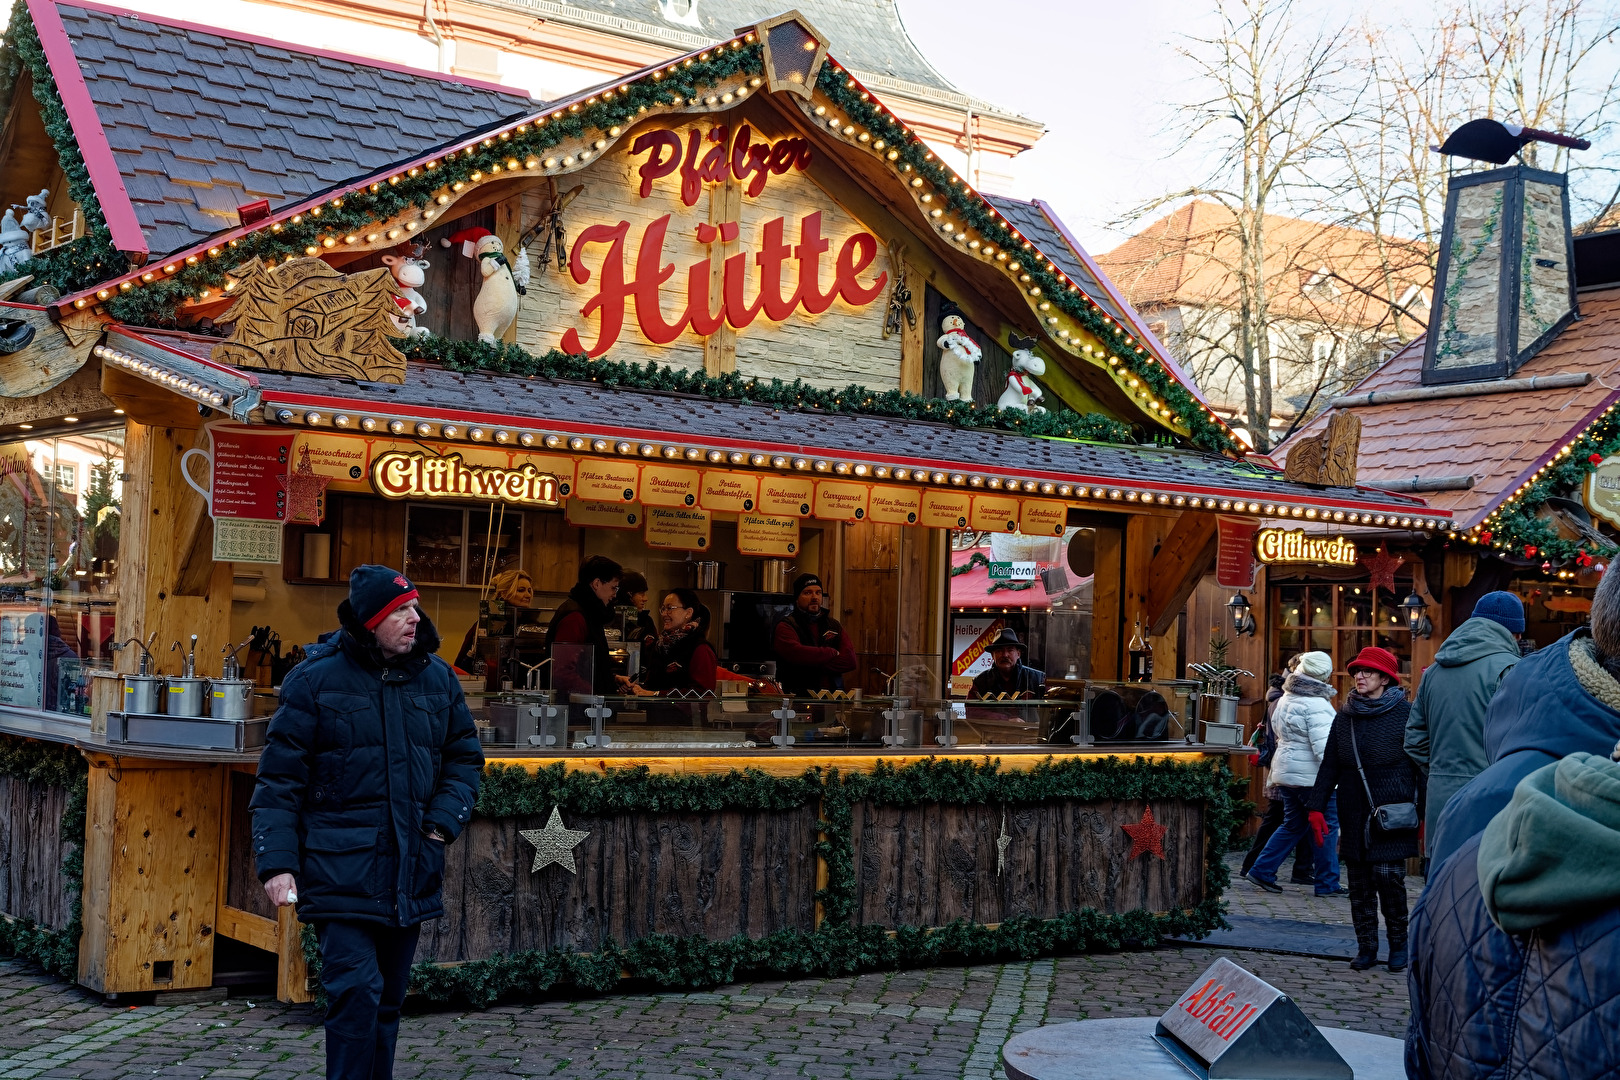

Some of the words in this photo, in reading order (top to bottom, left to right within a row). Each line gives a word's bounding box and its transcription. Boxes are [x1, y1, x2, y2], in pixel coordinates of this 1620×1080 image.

[628, 124, 813, 206] Pfälzer
[560, 211, 888, 358] Hütte
[322, 459, 348, 467] Brötchen
[381, 456, 558, 501] Glühwein
[580, 472, 603, 480] Pfälzer
[604, 474, 634, 482] Bratwurst
[650, 476, 690, 488] Bratwurst
[719, 479, 741, 488] Portion
[706, 487, 752, 499] Bratkartoffeln
[766, 488, 807, 500] Rindswurst
[822, 490, 861, 502] Currywurst
[872, 497, 892, 506] Pfälzer
[929, 501, 963, 511] Feuerwurst
[597, 504, 625, 514] Brötchen
[652, 509, 674, 519] Pfälzer
[675, 510, 691, 520] Teller
[692, 512, 705, 520] klein
[979, 505, 1011, 517] Saumagen
[1027, 508, 1062, 518] Leberknödel
[744, 517, 765, 525] Pfälzer
[766, 518, 781, 526] Teller
[782, 520, 794, 528] groß
[1263, 533, 1358, 562] Glühwein
[955, 625, 982, 635] Heißer
[956, 623, 1004, 674] Apfelwein
[1179, 978, 1257, 1042] Abfall
